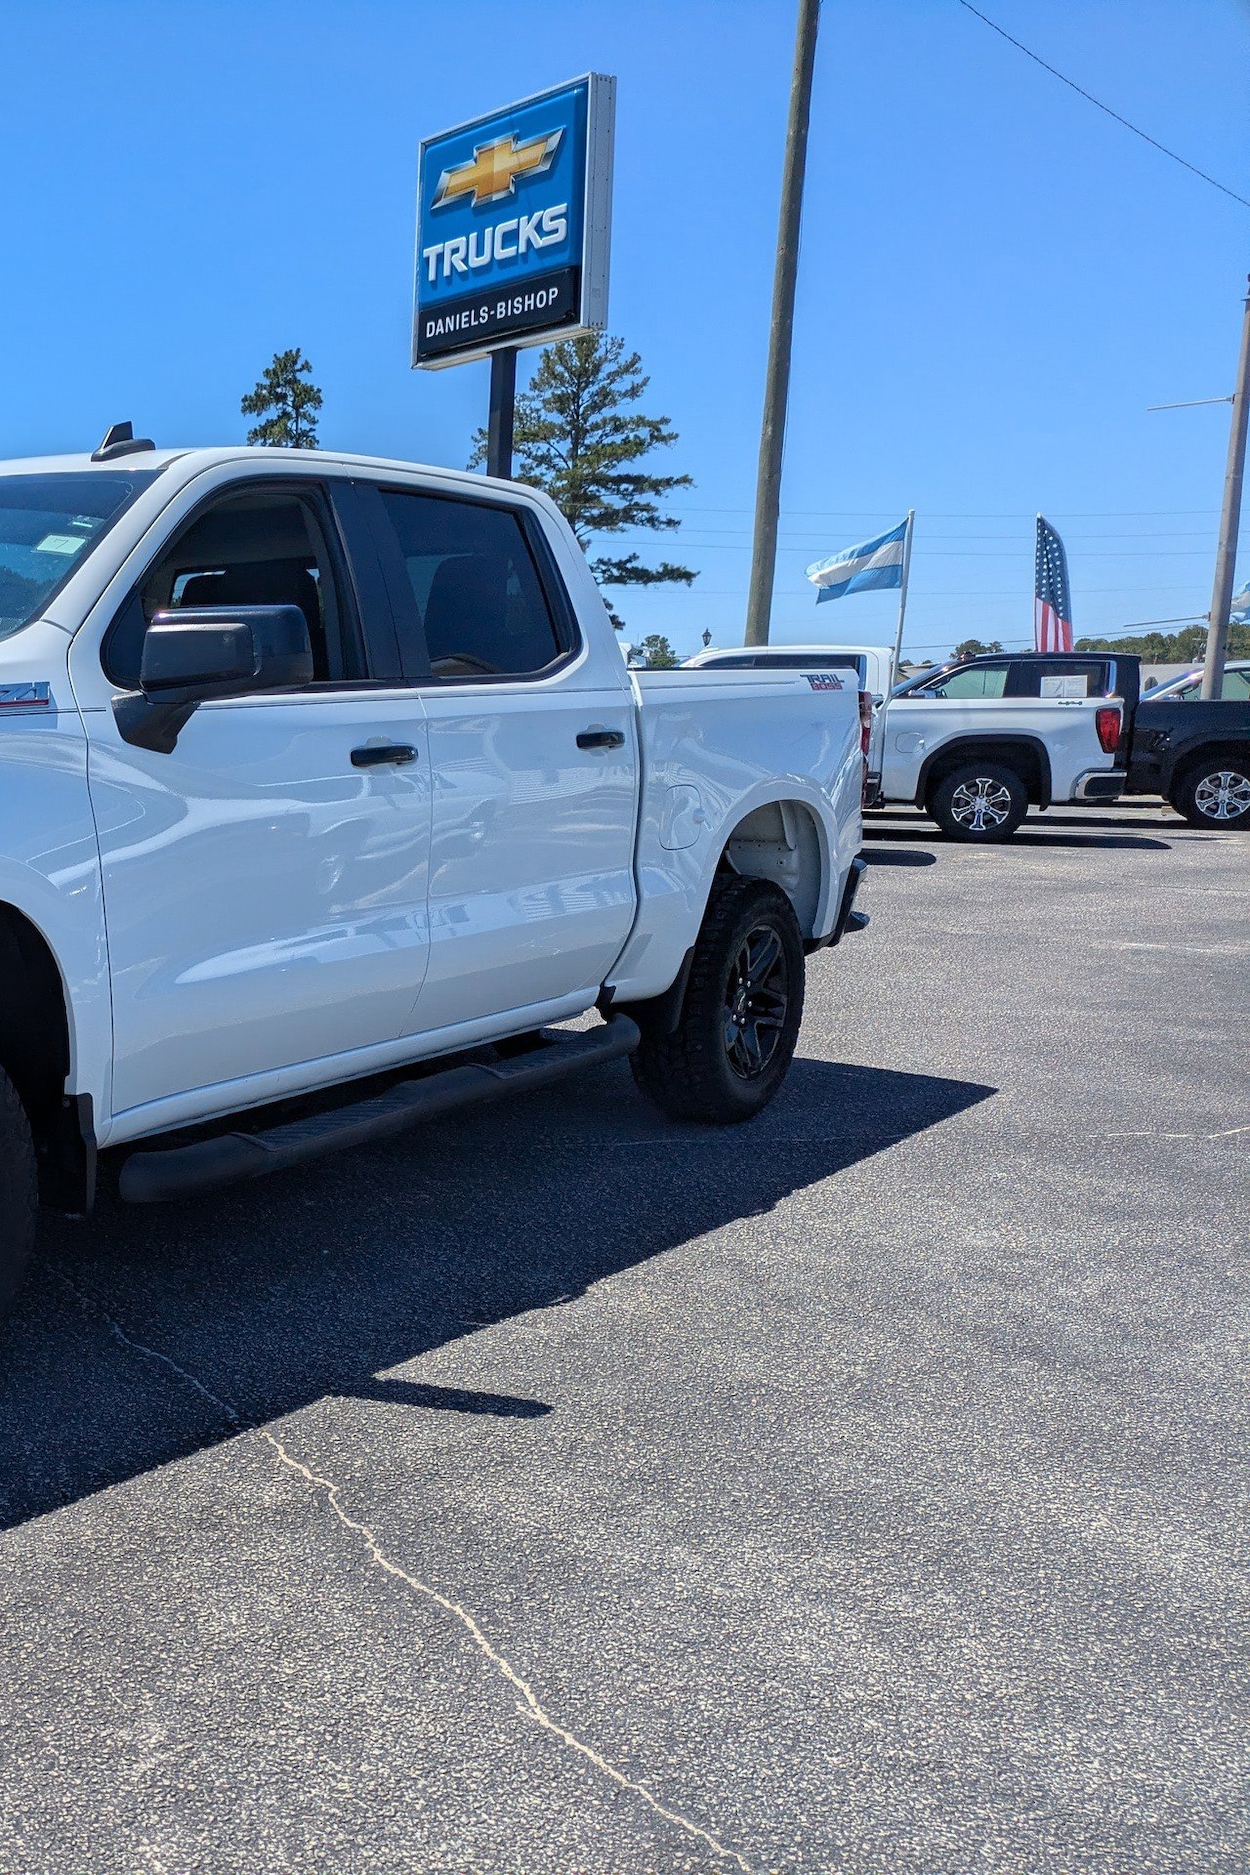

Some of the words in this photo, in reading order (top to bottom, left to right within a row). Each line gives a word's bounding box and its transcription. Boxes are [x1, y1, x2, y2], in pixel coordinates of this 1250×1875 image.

[423, 203, 568, 282] TRUCKS
[426, 287, 558, 338] DANIELS-BISHOP
[800, 674, 845, 683] TRAIL
